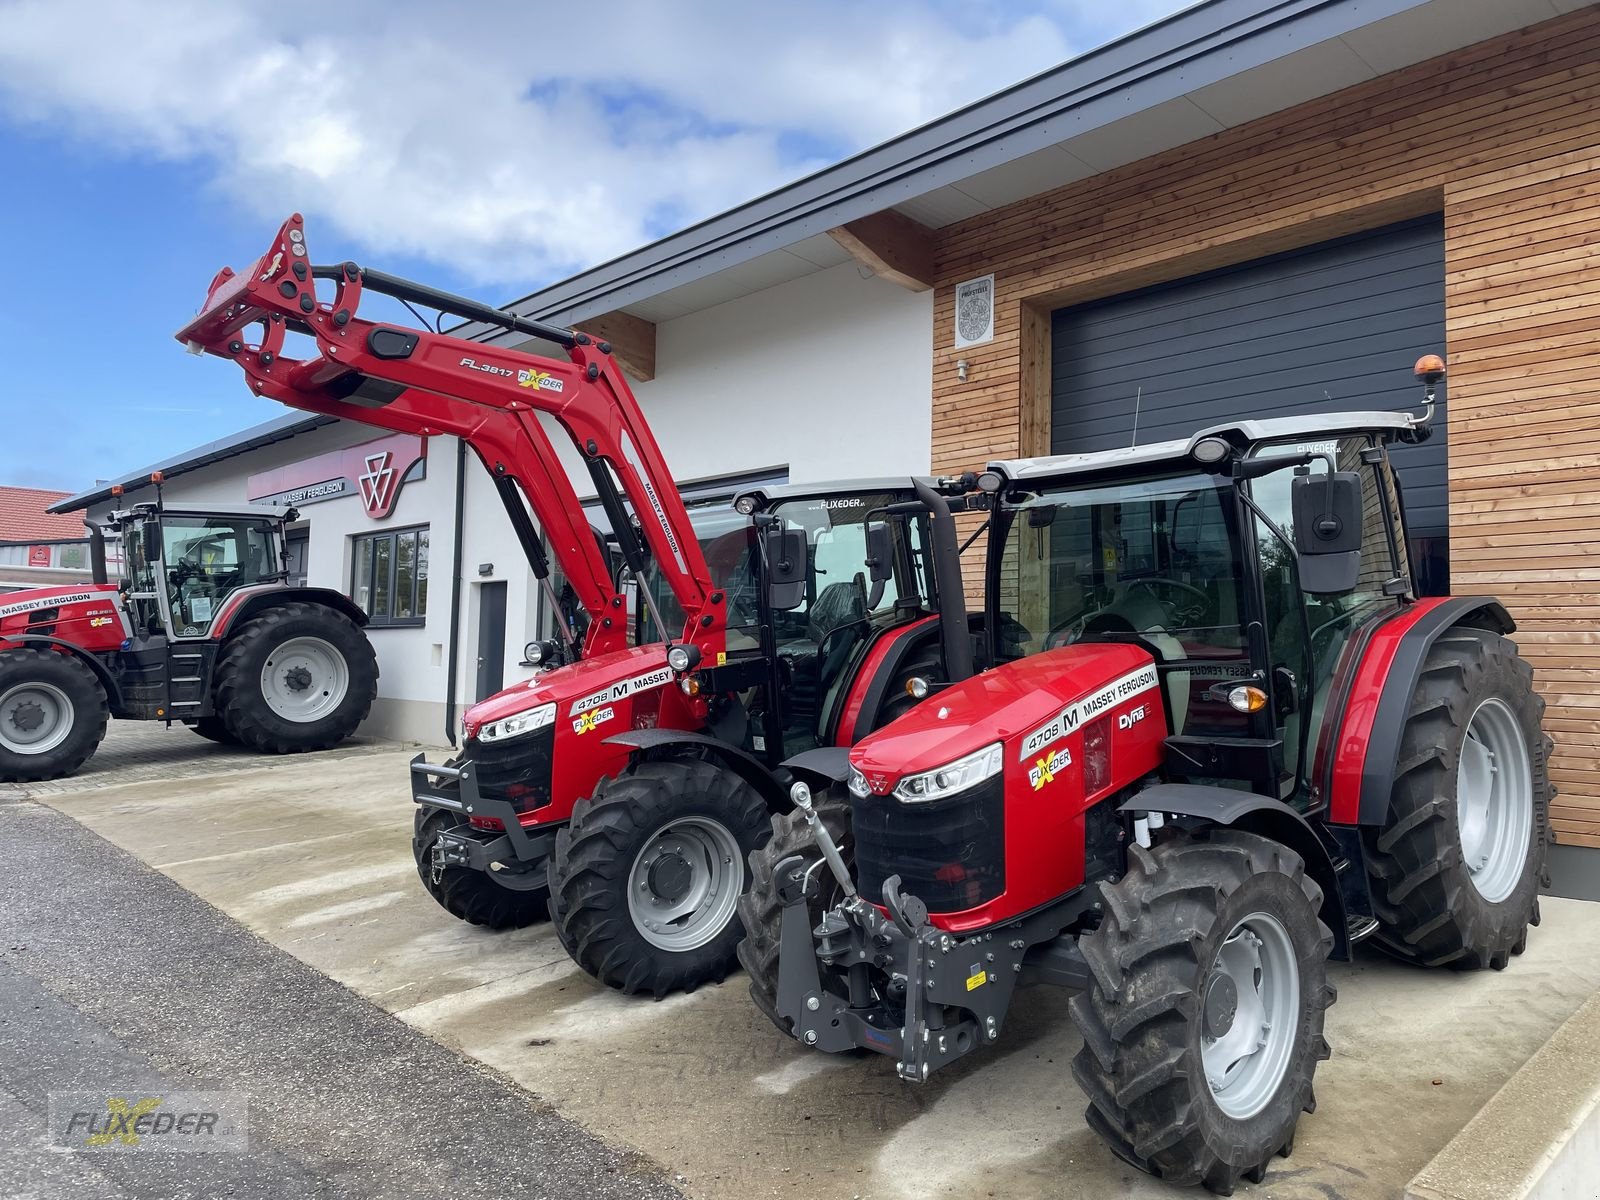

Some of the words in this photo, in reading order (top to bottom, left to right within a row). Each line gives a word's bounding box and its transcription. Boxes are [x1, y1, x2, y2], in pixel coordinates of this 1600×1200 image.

[459, 358, 514, 377] FL3817
[519, 371, 563, 390] FLIXEDER
[282, 491, 307, 503] MASSEY
[307, 482, 342, 498] FERGUSON
[644, 482, 662, 514] MASSEY
[659, 513, 679, 554] FERGUSON
[1, 602, 40, 615] MASSEY
[43, 593, 91, 607] FERGUSON
[578, 692, 608, 709] 4708
[612, 683, 628, 699] M
[634, 670, 669, 690] MASSEY
[574, 709, 613, 730] FLIXEDER
[1028, 724, 1059, 750] 4708
[1063, 708, 1079, 731] M
[1083, 688, 1117, 717] MASSEY
[1118, 670, 1155, 698] FERGUSON
[1031, 751, 1070, 783] FLIXEDER
